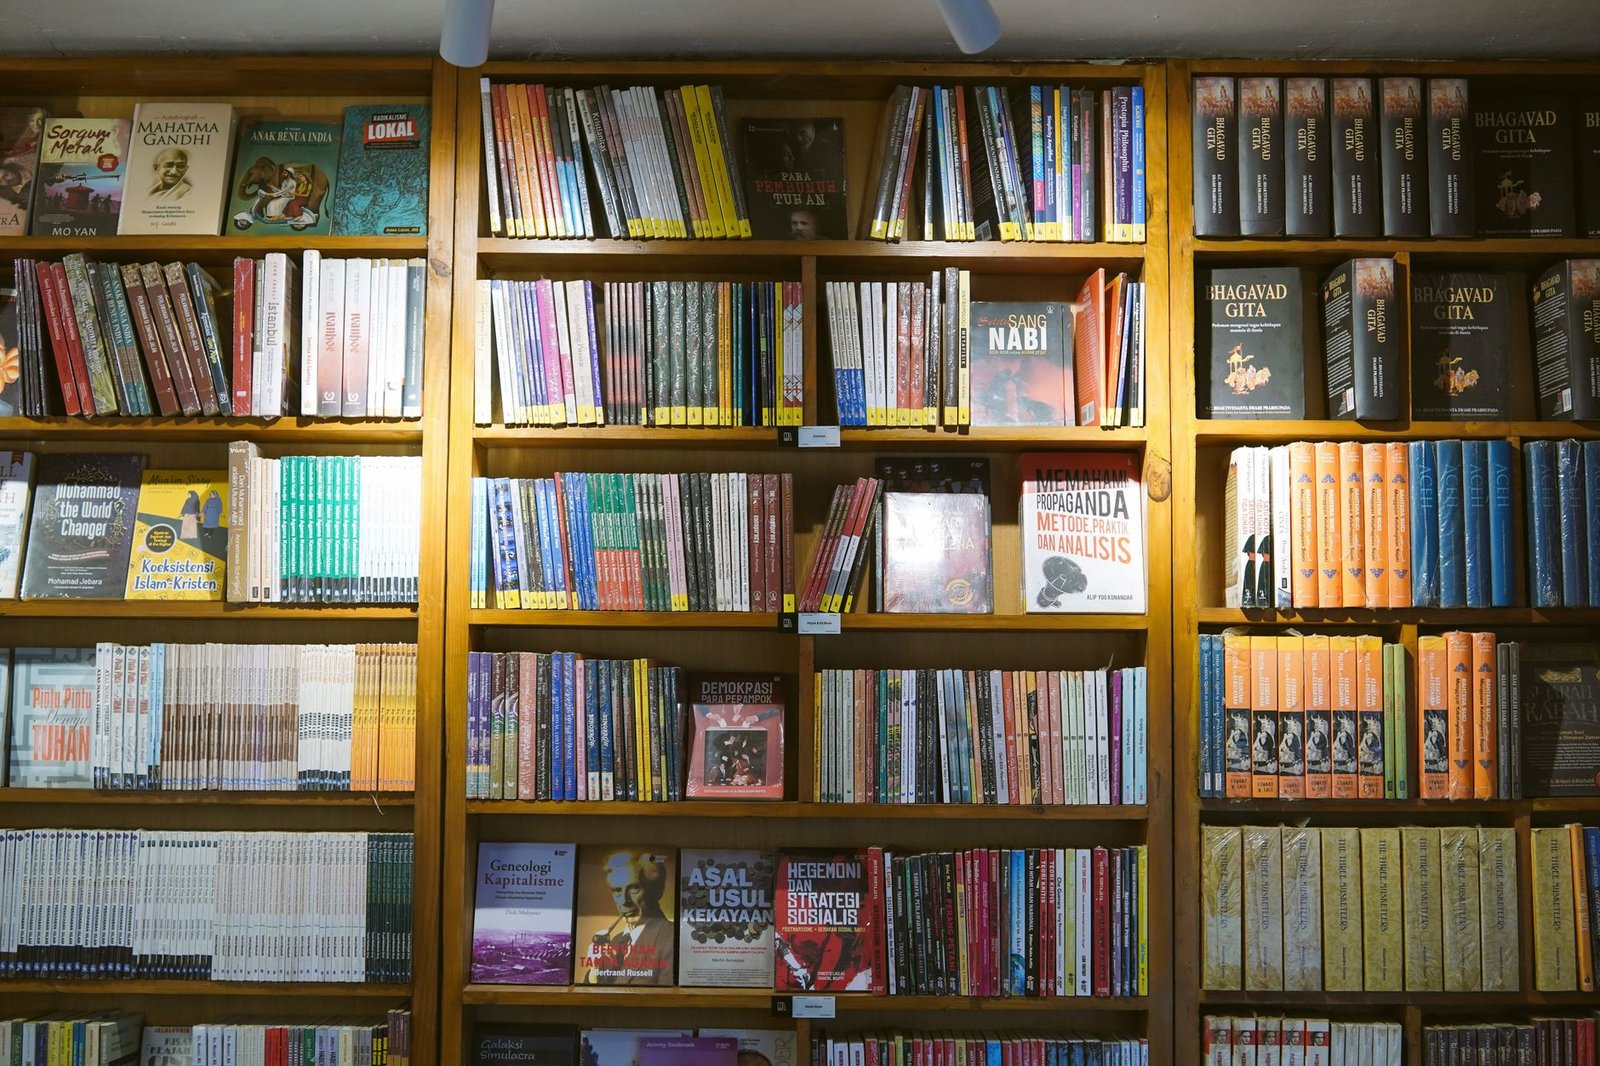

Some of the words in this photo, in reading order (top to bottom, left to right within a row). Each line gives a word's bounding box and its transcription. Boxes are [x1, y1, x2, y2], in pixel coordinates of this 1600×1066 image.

[1118, 97, 1129, 128] Protopia
[1474, 111, 1558, 128] BHAGAVAD
[47, 125, 110, 145] Sorgum
[138, 122, 219, 134] MAHATMA
[251, 132, 276, 142] ANAK
[278, 132, 306, 142] BENUA
[308, 132, 332, 142] INDIA
[367, 122, 414, 140] LOKAL
[592, 112, 607, 152] Kristianitas
[1495, 129, 1537, 144] GITA
[51, 139, 104, 158] Merah
[144, 134, 211, 146] GANDHI
[1207, 128, 1216, 149] GITA
[1216, 117, 1226, 160] BHAGAVAD
[1252, 128, 1261, 149] GITA
[1261, 117, 1270, 160] BHAGAVAD
[1298, 129, 1307, 150] GITA
[1307, 118, 1316, 161] BHAGAVAD
[1345, 129, 1354, 150] GITA
[1354, 118, 1364, 161] BHAGAVAD
[1395, 129, 1404, 150] GITA
[1404, 118, 1414, 161] BHAGAVAD
[1442, 129, 1451, 150] GITA
[1451, 118, 1460, 161] BHAGAVAD
[1118, 130, 1130, 173] Philosophia
[754, 180, 838, 192] PEMBUNUH
[782, 172, 812, 180] PARA
[52, 228, 72, 236] MO
[74, 228, 97, 236] YAN
[1206, 284, 1288, 301] BHAGAVAD
[1332, 287, 1343, 298] GITA
[1414, 287, 1494, 303] BHAGAVAD
[46, 290, 56, 317] Pertunjukan
[52, 318, 60, 340] Indonesia
[1225, 302, 1267, 318] GITA
[1433, 305, 1474, 320] GITA
[266, 302, 279, 346] Istanbul
[1008, 314, 1046, 328] SANG
[1367, 309, 1376, 333] GITA
[1376, 299, 1386, 344] BHAGAVAD
[112, 325, 122, 344] INDIA
[122, 325, 132, 344] INDIA
[325, 312, 338, 353] Ivanhoe
[350, 312, 361, 353] Ivanhoe
[989, 327, 1048, 350] NABI
[1036, 469, 1130, 492] MEMAHAMI
[1420, 464, 1432, 508] ACEH
[1446, 464, 1458, 508] ACEH
[1471, 464, 1484, 508] ACEH
[1496, 464, 1509, 508] ACEH
[57, 484, 120, 502] Muhammad
[60, 502, 80, 518] the
[82, 501, 114, 518] World
[238, 489, 246, 526] Muhammad
[1036, 490, 1130, 519] PROPAGANDA
[61, 519, 108, 540] Changer
[1037, 511, 1092, 534] METODE,
[1093, 518, 1129, 534] PRAKTIK
[1038, 534, 1056, 552] DAN
[1058, 536, 1131, 564] ANALISIS
[142, 558, 214, 574] Koeksistensi
[48, 577, 78, 586] Mohamad
[80, 577, 102, 586] Jebara
[134, 576, 217, 590] Islam-Kristen
[702, 681, 774, 694] DEMOKRASI
[32, 688, 61, 709] Pintu
[64, 688, 92, 709] Pintu
[702, 695, 723, 704] PARA
[725, 694, 773, 704] PERAMPOK
[33, 725, 90, 762] TUHAN
[1550, 839, 1558, 853] THE
[490, 858, 552, 876] Geneologi
[787, 862, 862, 879] HEGEMONI
[484, 873, 564, 888] Kapitalisme
[688, 868, 753, 887] ASAL
[787, 880, 812, 892] DAN
[710, 888, 771, 908] USUL
[787, 892, 860, 909] STRATEGI
[1340, 882, 1348, 931] MUSKETEERS
[1380, 884, 1388, 932] MUSKETEERS
[682, 908, 774, 922] KEKAYAAN
[787, 908, 858, 926] SOSIALIS
[945, 898, 953, 935] PERANG
[946, 938, 956, 971] PETANI
[594, 970, 626, 978] Bertrand
[626, 969, 654, 978] Russell
[480, 1039, 523, 1051] Galaksi
[480, 1050, 537, 1061] Simulacra
